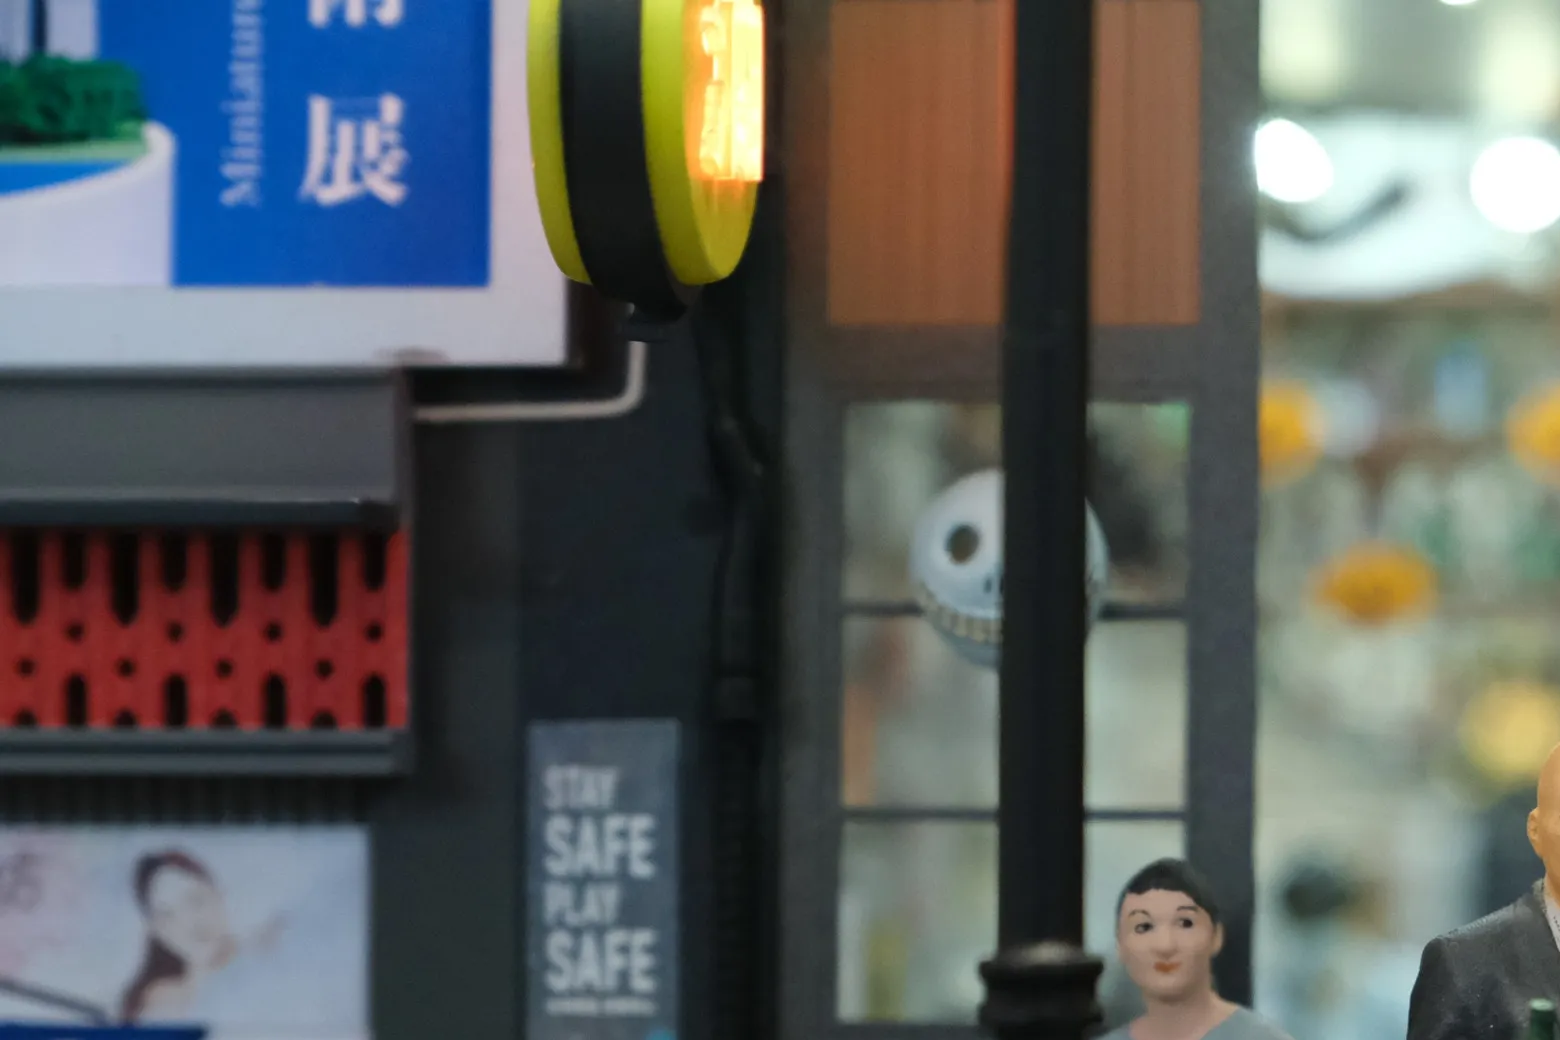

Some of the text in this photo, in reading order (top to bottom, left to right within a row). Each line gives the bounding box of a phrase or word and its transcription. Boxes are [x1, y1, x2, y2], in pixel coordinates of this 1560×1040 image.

[544, 766, 617, 809] STAY
[545, 814, 656, 878] SAFE
[545, 882, 620, 926] PLAY
[546, 928, 656, 990] SAFE
